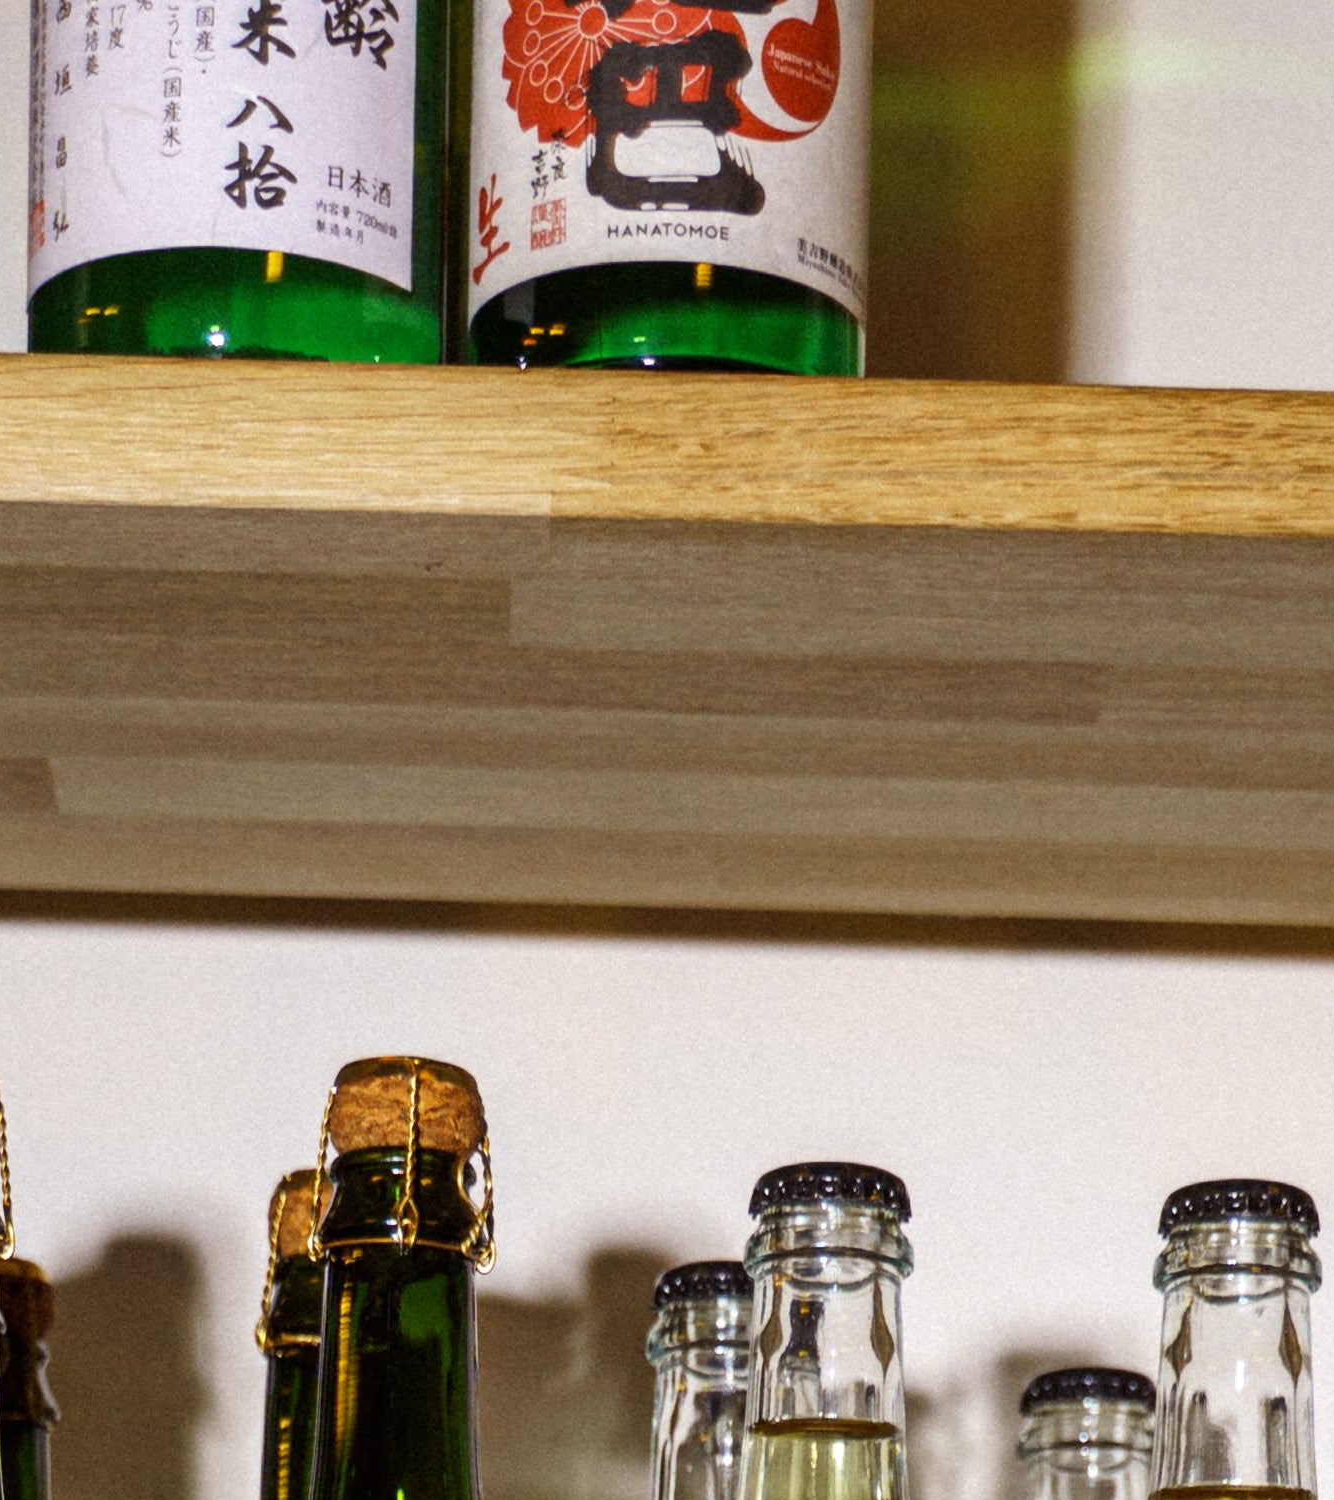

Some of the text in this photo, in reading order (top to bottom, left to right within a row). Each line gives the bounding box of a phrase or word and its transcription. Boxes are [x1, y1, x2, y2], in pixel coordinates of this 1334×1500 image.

[327, 165, 392, 208] 日本酒
[607, 222, 730, 241] HANATOMOE
